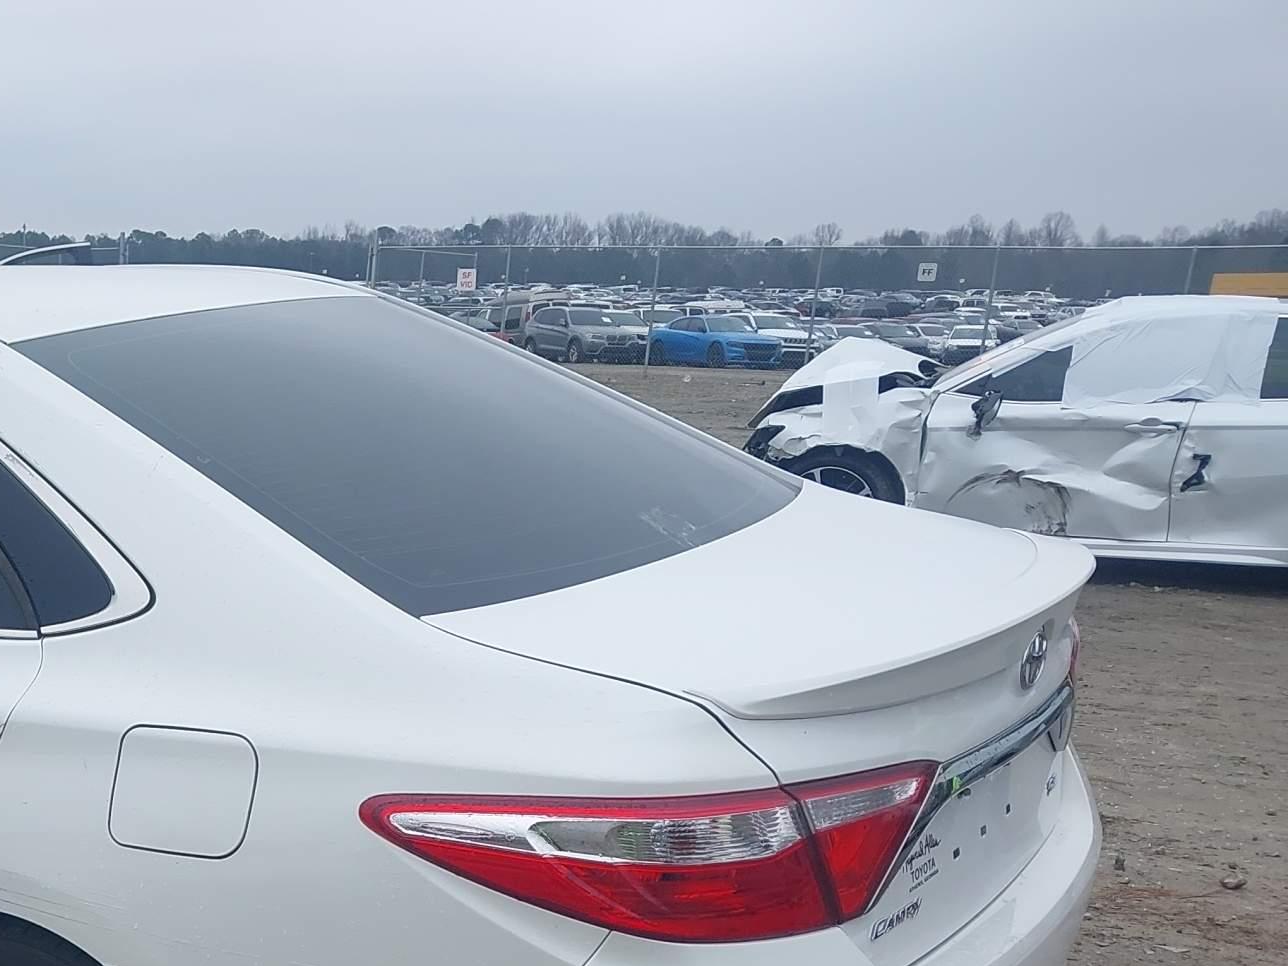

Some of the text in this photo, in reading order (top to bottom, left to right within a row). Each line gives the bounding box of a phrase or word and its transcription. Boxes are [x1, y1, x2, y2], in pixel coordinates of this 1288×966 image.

[462, 271, 472, 279] SF
[921, 268, 934, 276] FF
[910, 857, 936, 883] TOYOTA
[869, 896, 922, 941] CAMRY
